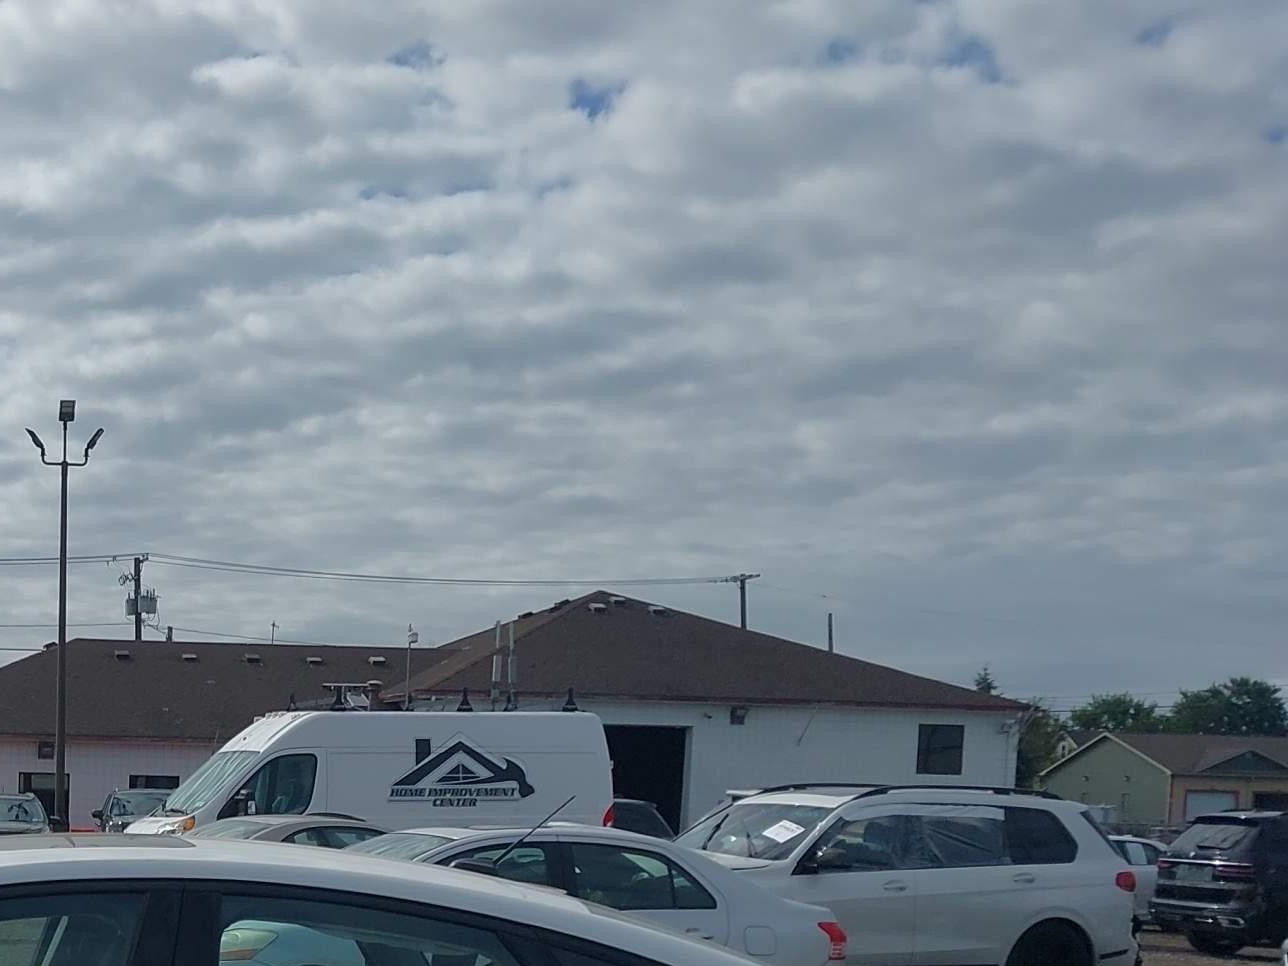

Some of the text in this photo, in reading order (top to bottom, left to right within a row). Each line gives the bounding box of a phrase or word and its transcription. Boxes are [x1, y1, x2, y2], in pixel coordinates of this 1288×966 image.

[389, 787, 518, 797] HOME IMPROVEMENT
[432, 798, 478, 807] CENTER
